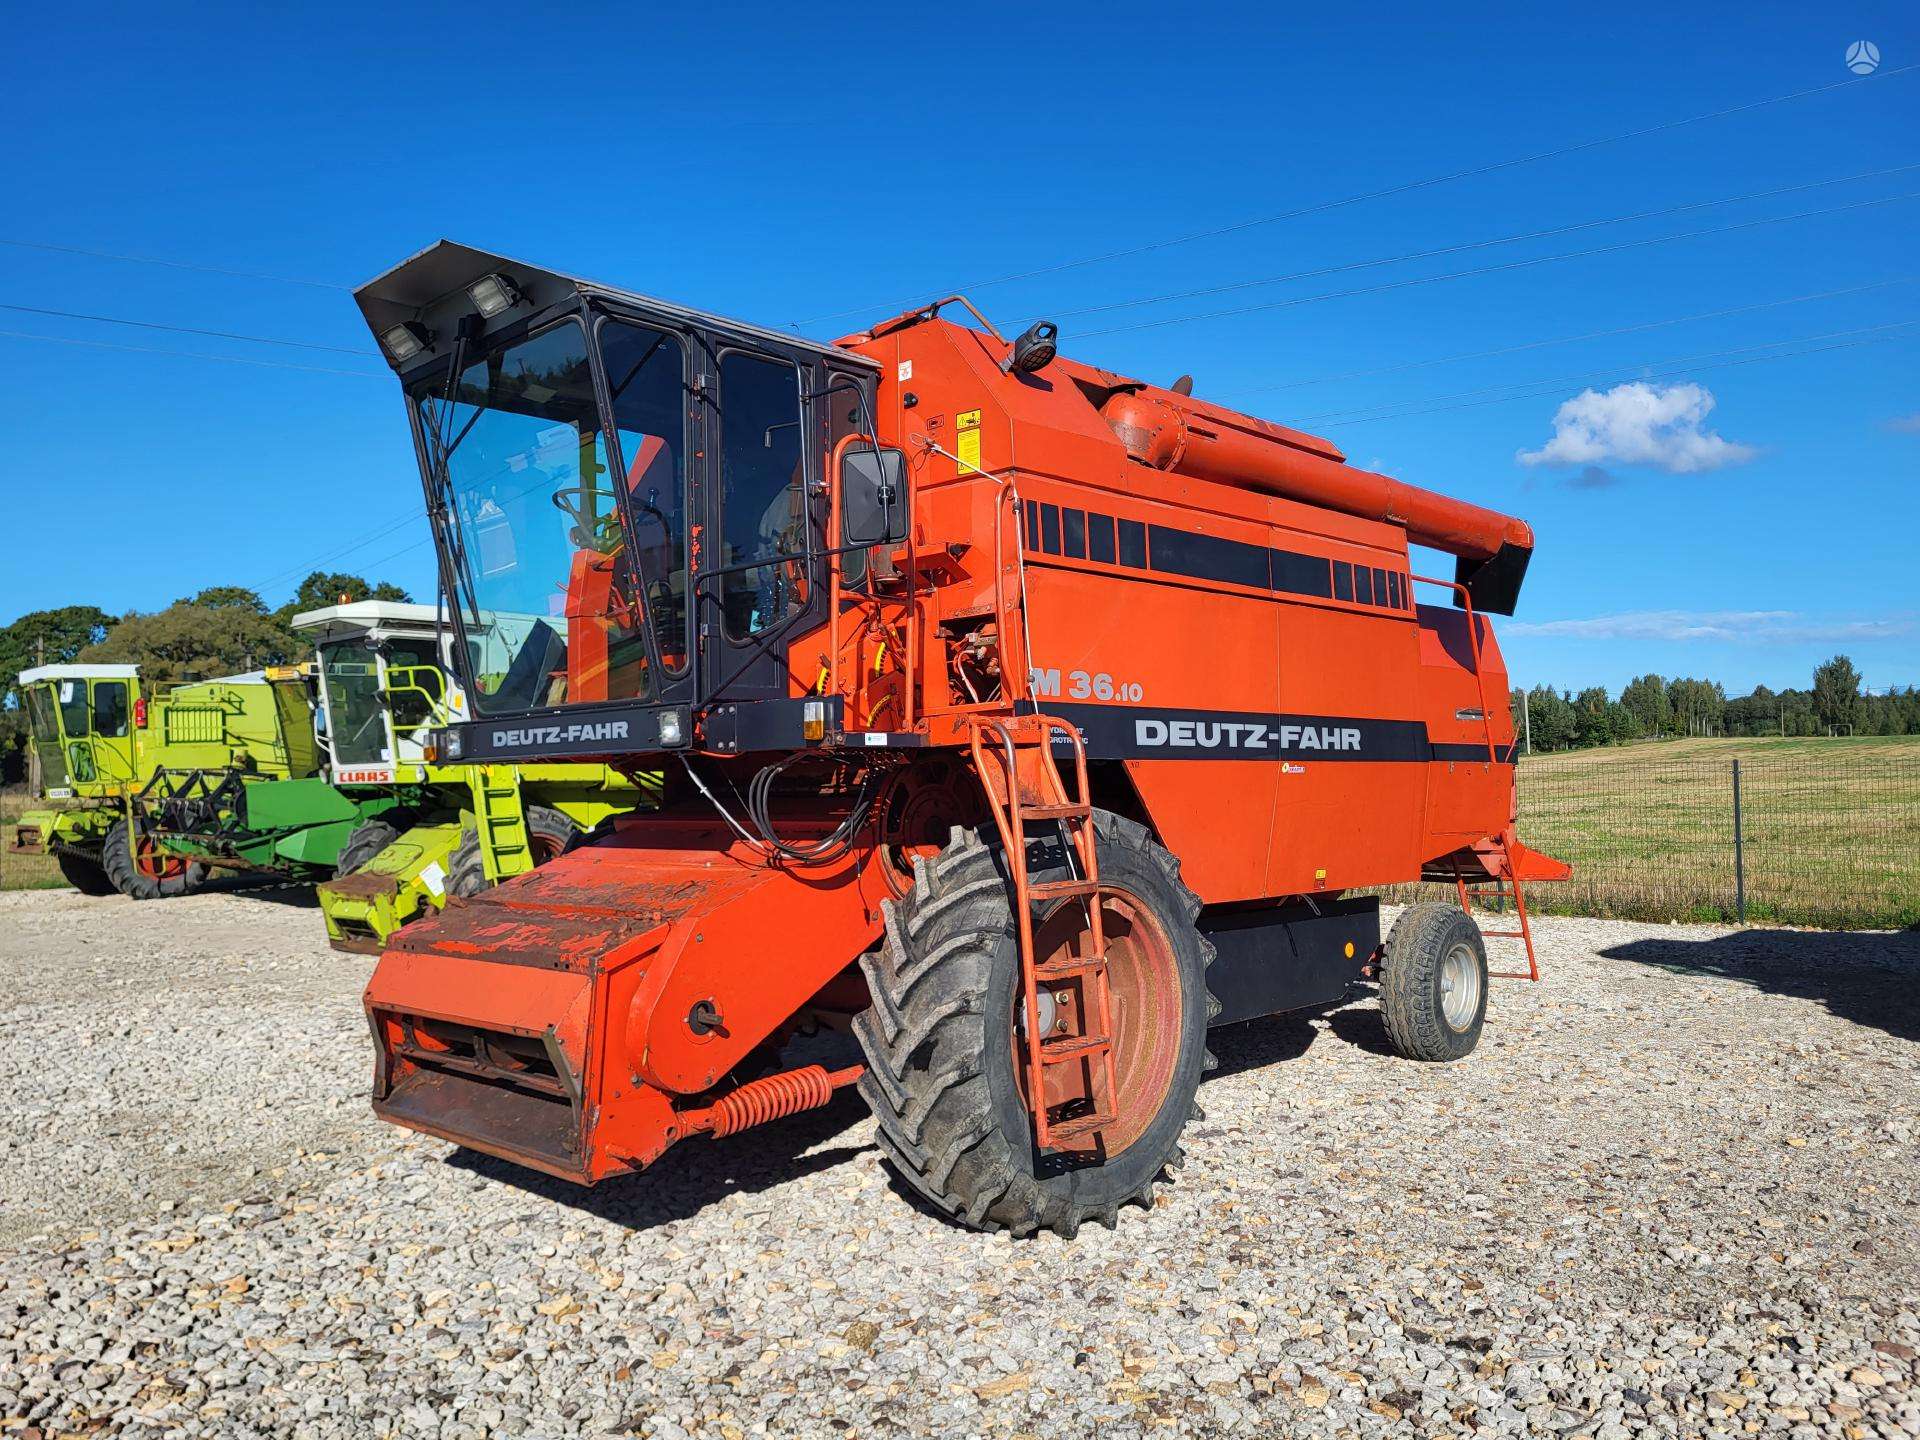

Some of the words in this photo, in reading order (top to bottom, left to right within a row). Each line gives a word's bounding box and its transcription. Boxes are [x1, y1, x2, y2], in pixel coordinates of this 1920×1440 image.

[1068, 671, 1144, 702] 36.10
[493, 721, 629, 747] DEUTZ-FAHR
[1135, 720, 1361, 750] DEUTZ-FAHR
[339, 771, 389, 782] CLAAS
